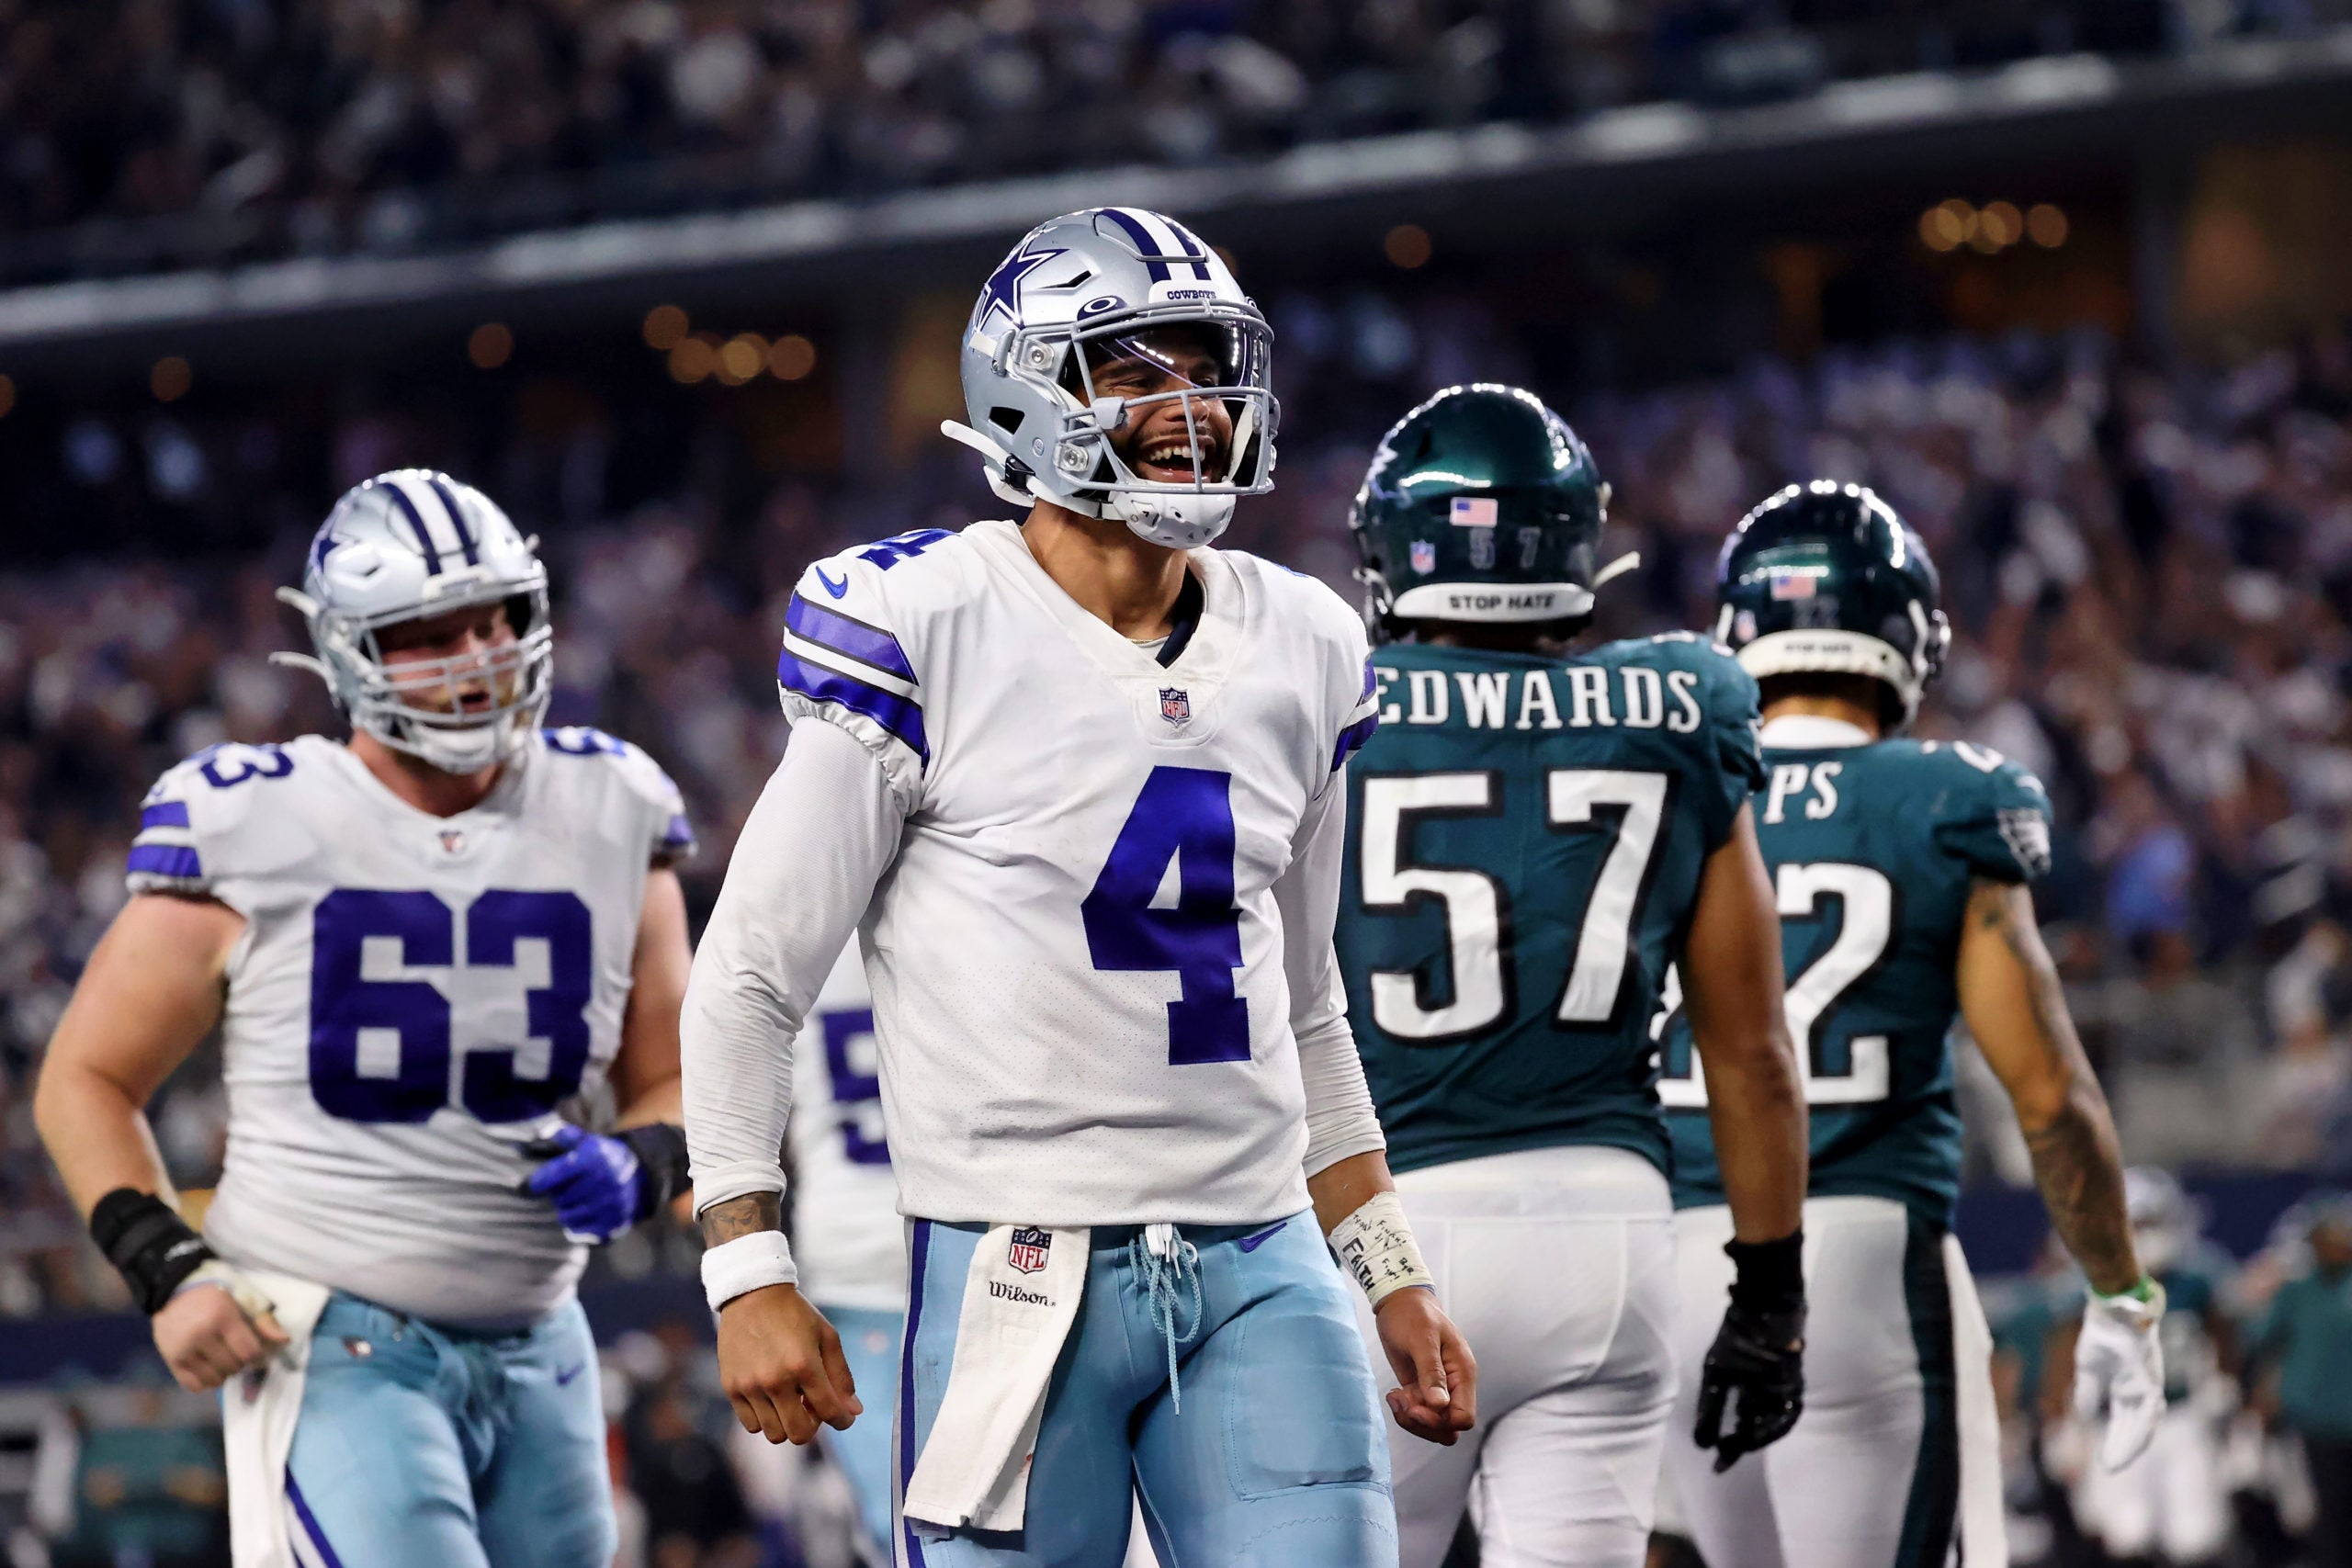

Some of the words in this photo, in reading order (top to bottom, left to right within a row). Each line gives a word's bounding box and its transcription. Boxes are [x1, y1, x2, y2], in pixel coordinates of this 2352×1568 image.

[1167, 289, 1217, 300] COWBOYS
[1449, 594, 1501, 610] STOP
[1162, 700, 1188, 719] NFL
[1376, 665, 1702, 734] EDWARDS
[1080, 764, 1251, 1066] 4
[1361, 769, 1668, 1040] 57
[310, 888, 592, 1125] 63
[820, 1008, 892, 1166] 5
[1011, 1244, 1046, 1269] NFL
[1342, 1236, 1376, 1292] FAITH
[989, 1280, 1049, 1307] Wilson
